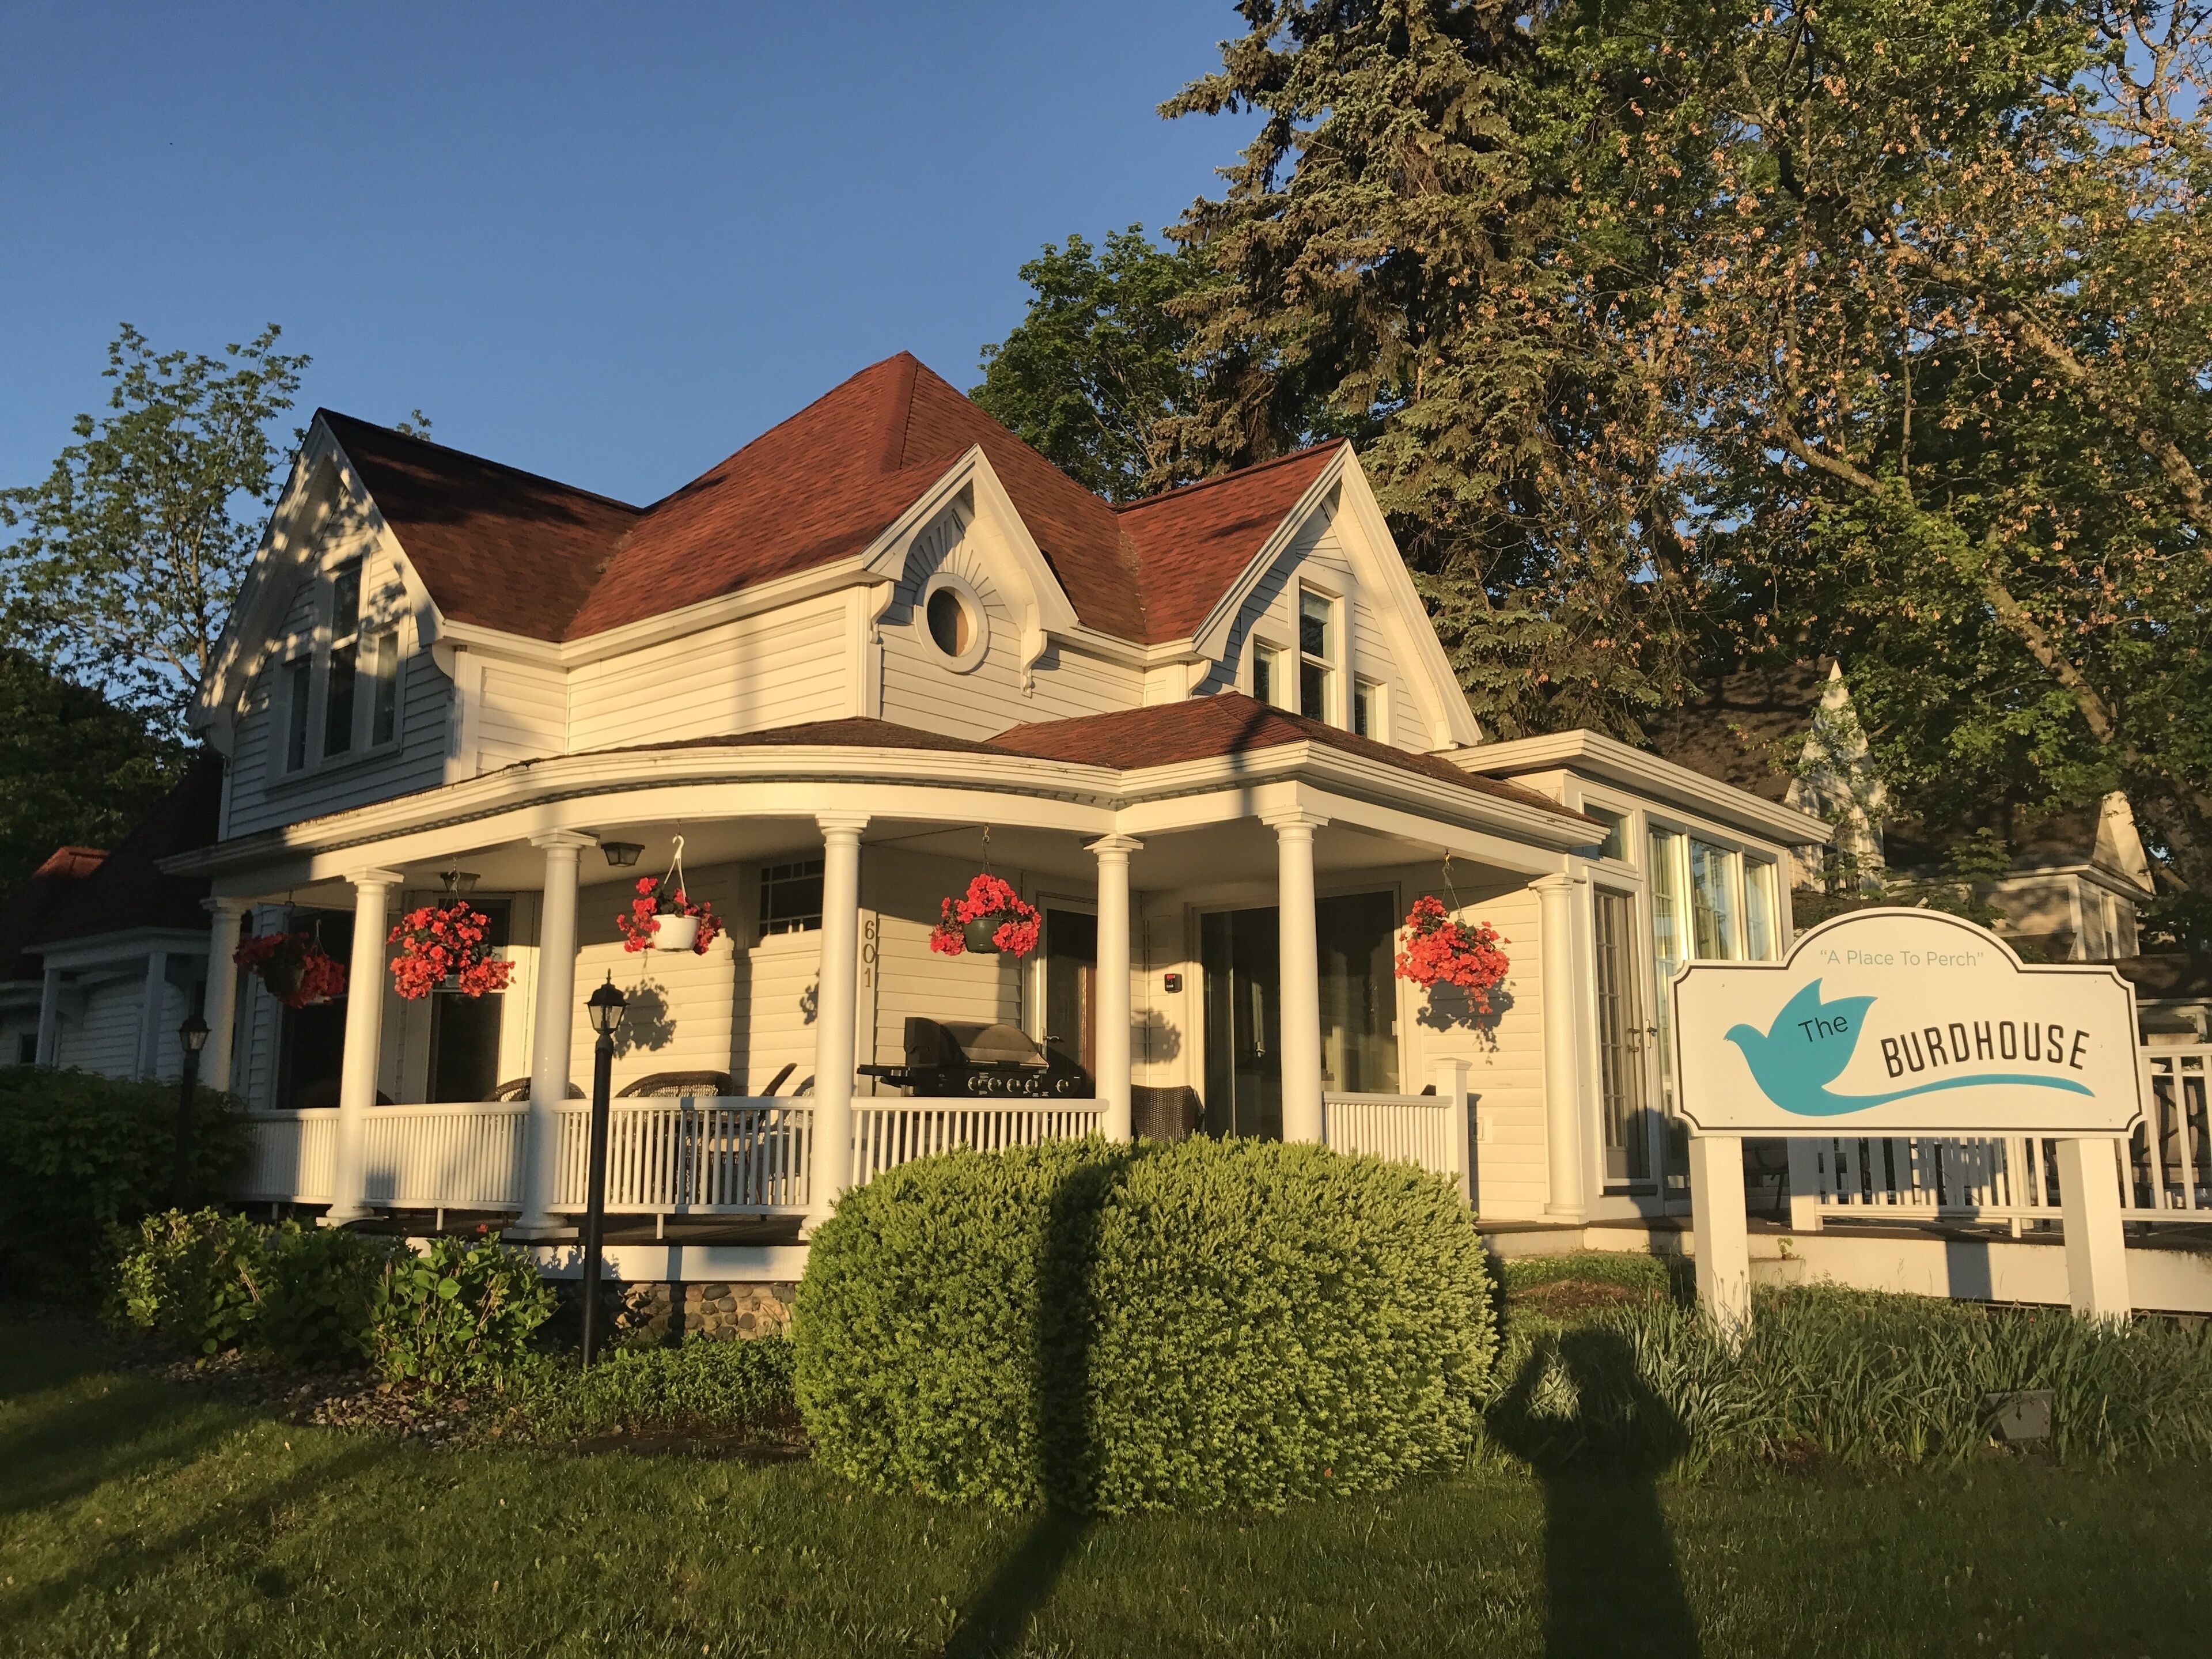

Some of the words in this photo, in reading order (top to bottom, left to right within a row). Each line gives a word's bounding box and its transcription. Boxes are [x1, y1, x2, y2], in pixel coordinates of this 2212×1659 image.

[863, 920, 876, 988] 601
[1847, 950, 1894, 965] Place
[1900, 951, 1921, 965] To
[1798, 1016, 1848, 1043] The
[1880, 1021, 2090, 1078] BURDHOUSE
